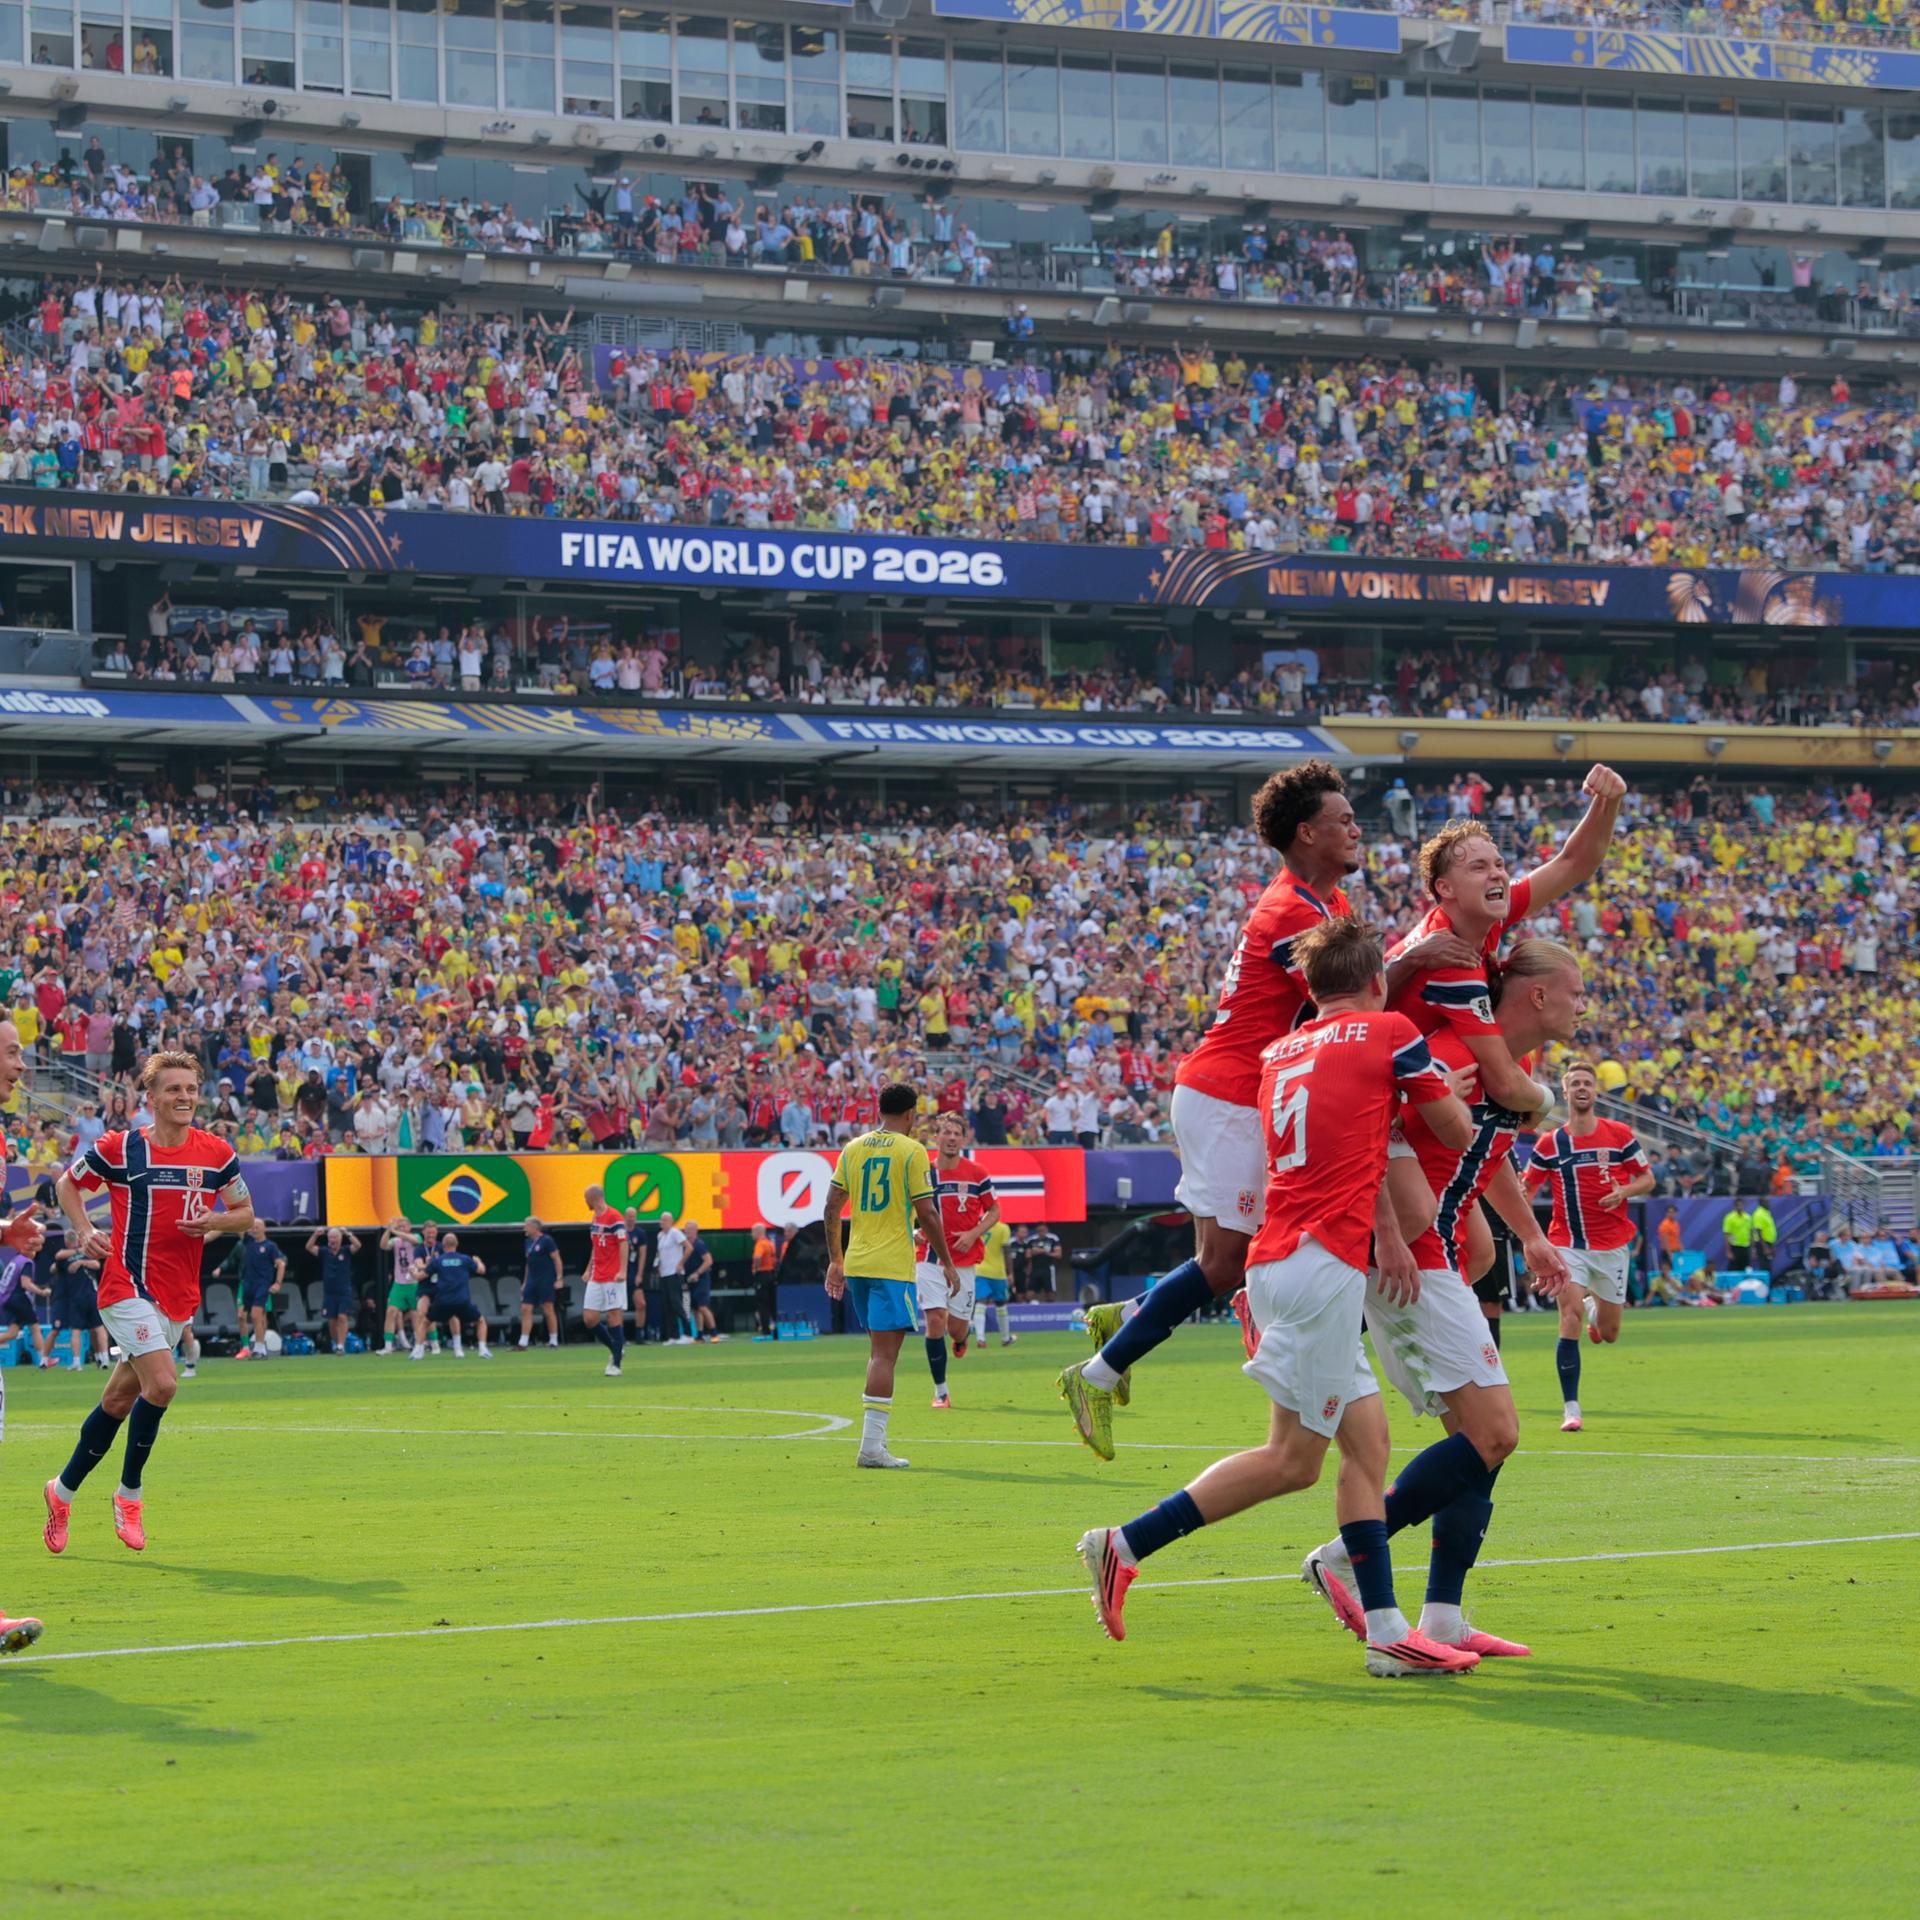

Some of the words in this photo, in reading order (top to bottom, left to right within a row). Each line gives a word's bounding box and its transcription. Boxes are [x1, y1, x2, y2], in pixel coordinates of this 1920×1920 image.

[44, 506, 124, 540] NEW
[130, 512, 263, 548] JERSEY
[561, 532, 644, 570] FIFA
[647, 536, 785, 577] WORLD
[791, 544, 867, 580] CUP
[872, 547, 1004, 586] 2026
[1268, 568, 1336, 597] NEW
[1340, 570, 1422, 600] YORK
[1427, 574, 1494, 603] NEW
[1497, 576, 1610, 607] JERSEY
[827, 721, 928, 741] FIFA
[920, 725, 1076, 744] WORLD
[1077, 728, 1158, 746] CUP
[1161, 730, 1304, 748] 2026
[1271, 1058, 1316, 1173] 5
[860, 1157, 890, 1212] 13
